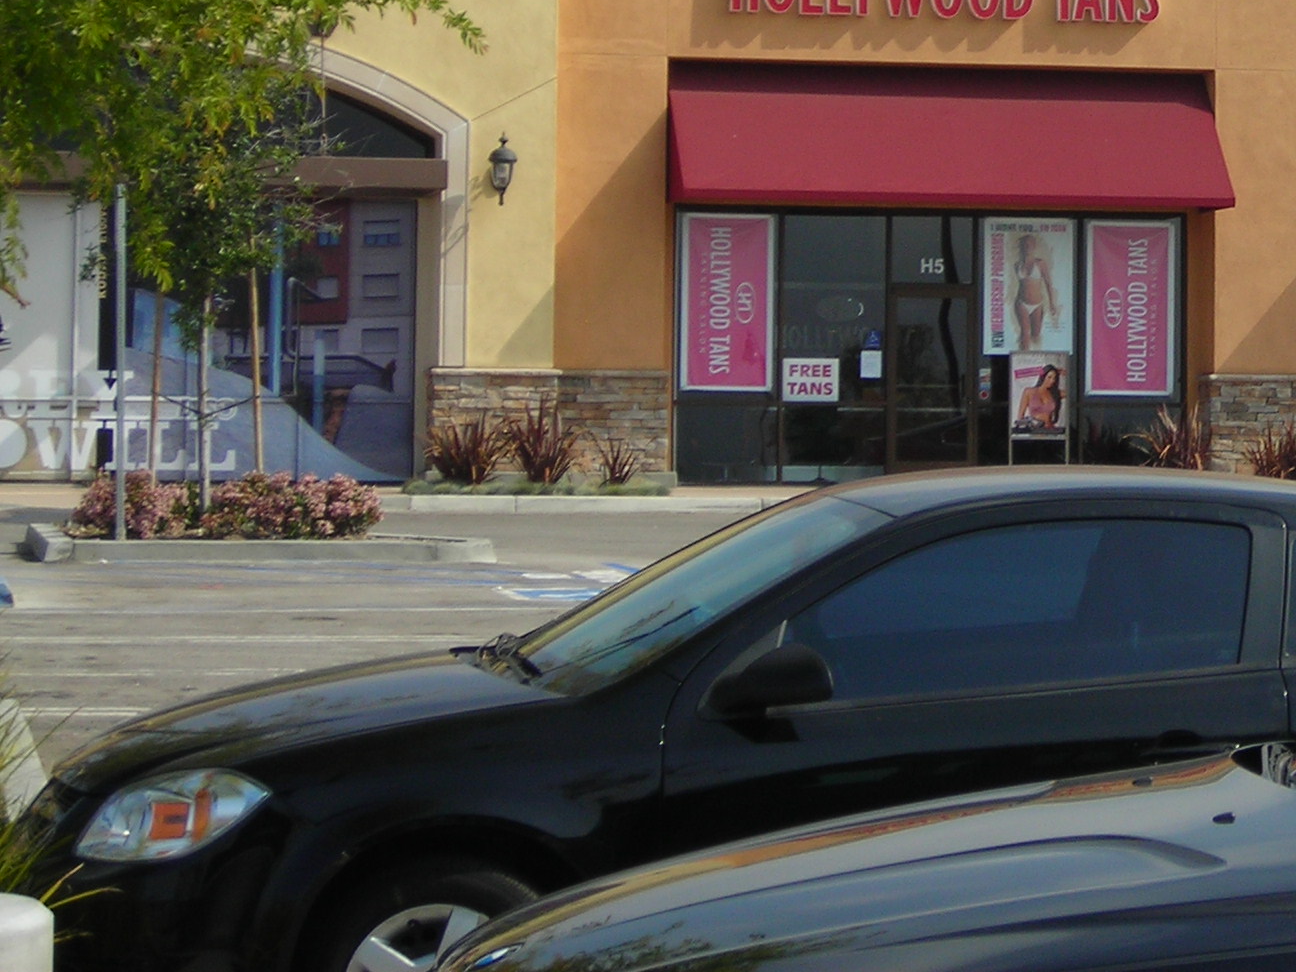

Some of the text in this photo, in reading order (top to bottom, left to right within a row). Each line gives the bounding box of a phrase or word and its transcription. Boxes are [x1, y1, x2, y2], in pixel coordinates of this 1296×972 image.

[920, 258, 945, 274] H5
[708, 227, 732, 374] HOLLYWOOD TANS
[1126, 238, 1148, 382] HOLLYWOOD TANS
[789, 364, 831, 377] FREE
[787, 382, 833, 396] TANS
